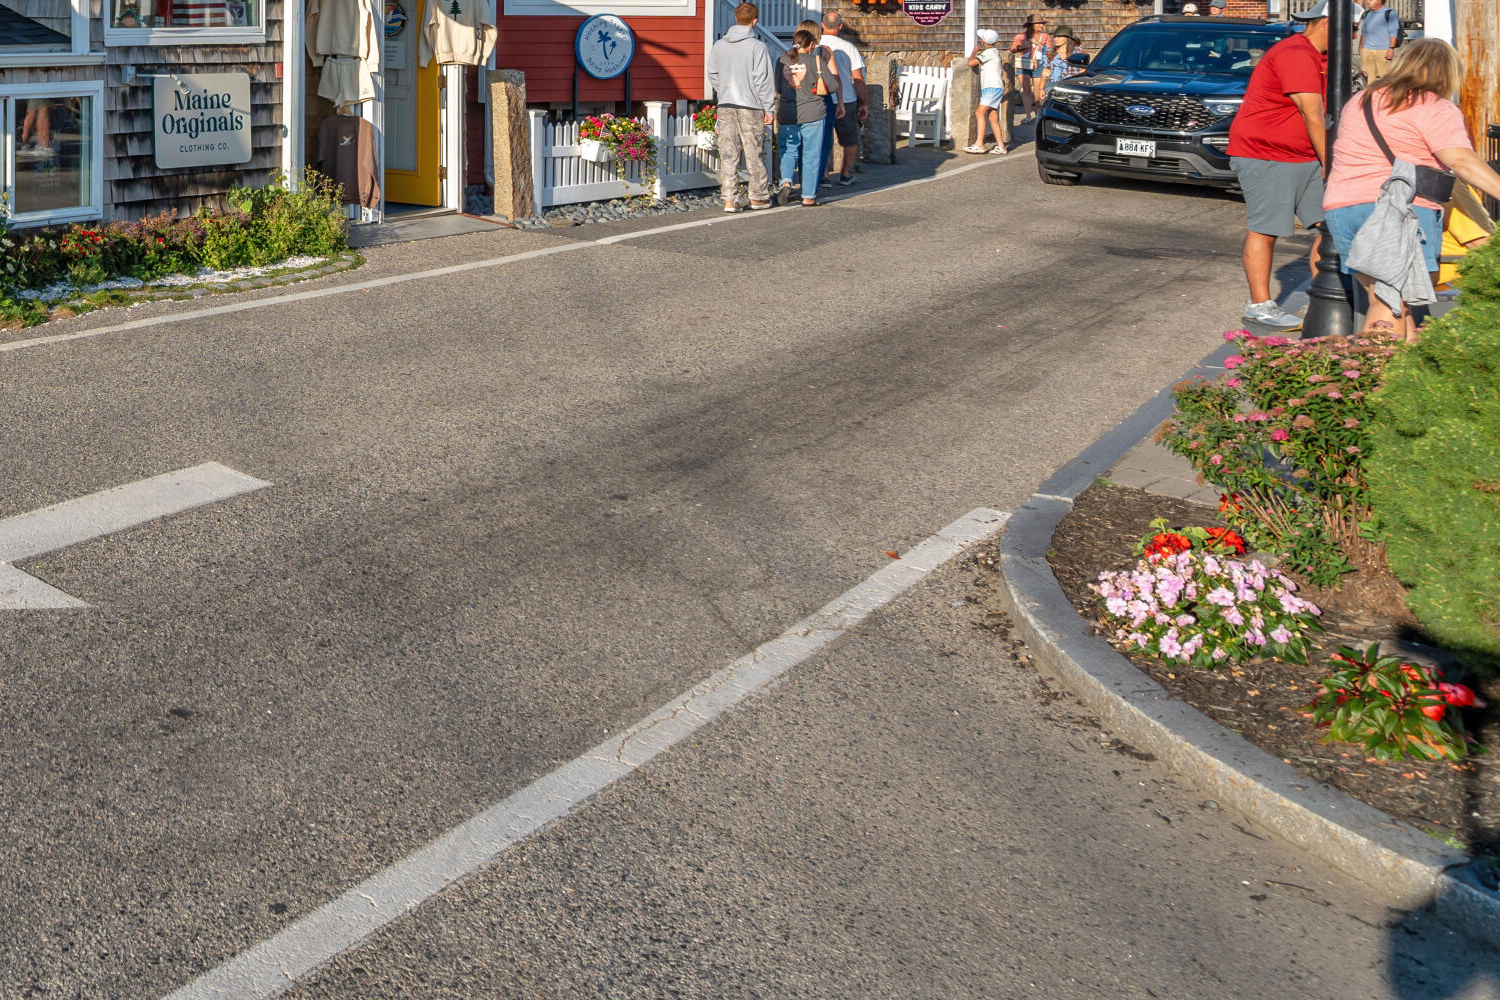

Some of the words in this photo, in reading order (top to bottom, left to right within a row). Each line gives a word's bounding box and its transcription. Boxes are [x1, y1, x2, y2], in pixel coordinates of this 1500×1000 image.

[173, 88, 231, 111] Maine
[161, 110, 244, 139] Originals
[179, 143, 215, 153] CLOTHING
[217, 142, 230, 151] CO.
